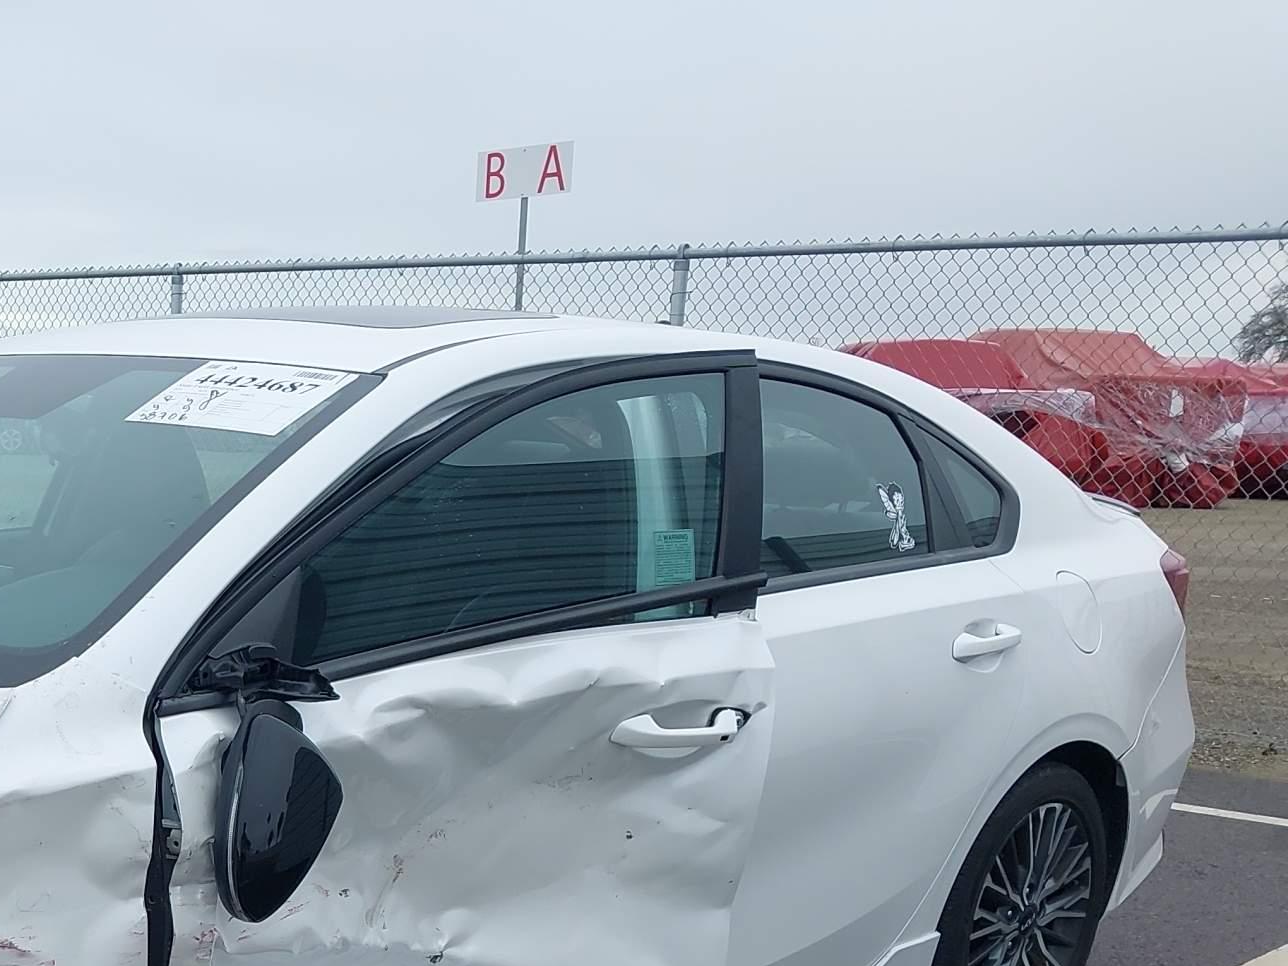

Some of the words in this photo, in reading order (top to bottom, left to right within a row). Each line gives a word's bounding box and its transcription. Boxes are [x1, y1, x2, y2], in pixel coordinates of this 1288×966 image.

[485, 152, 505, 199] B
[537, 145, 565, 194] A
[195, 374, 321, 395] 44424687
